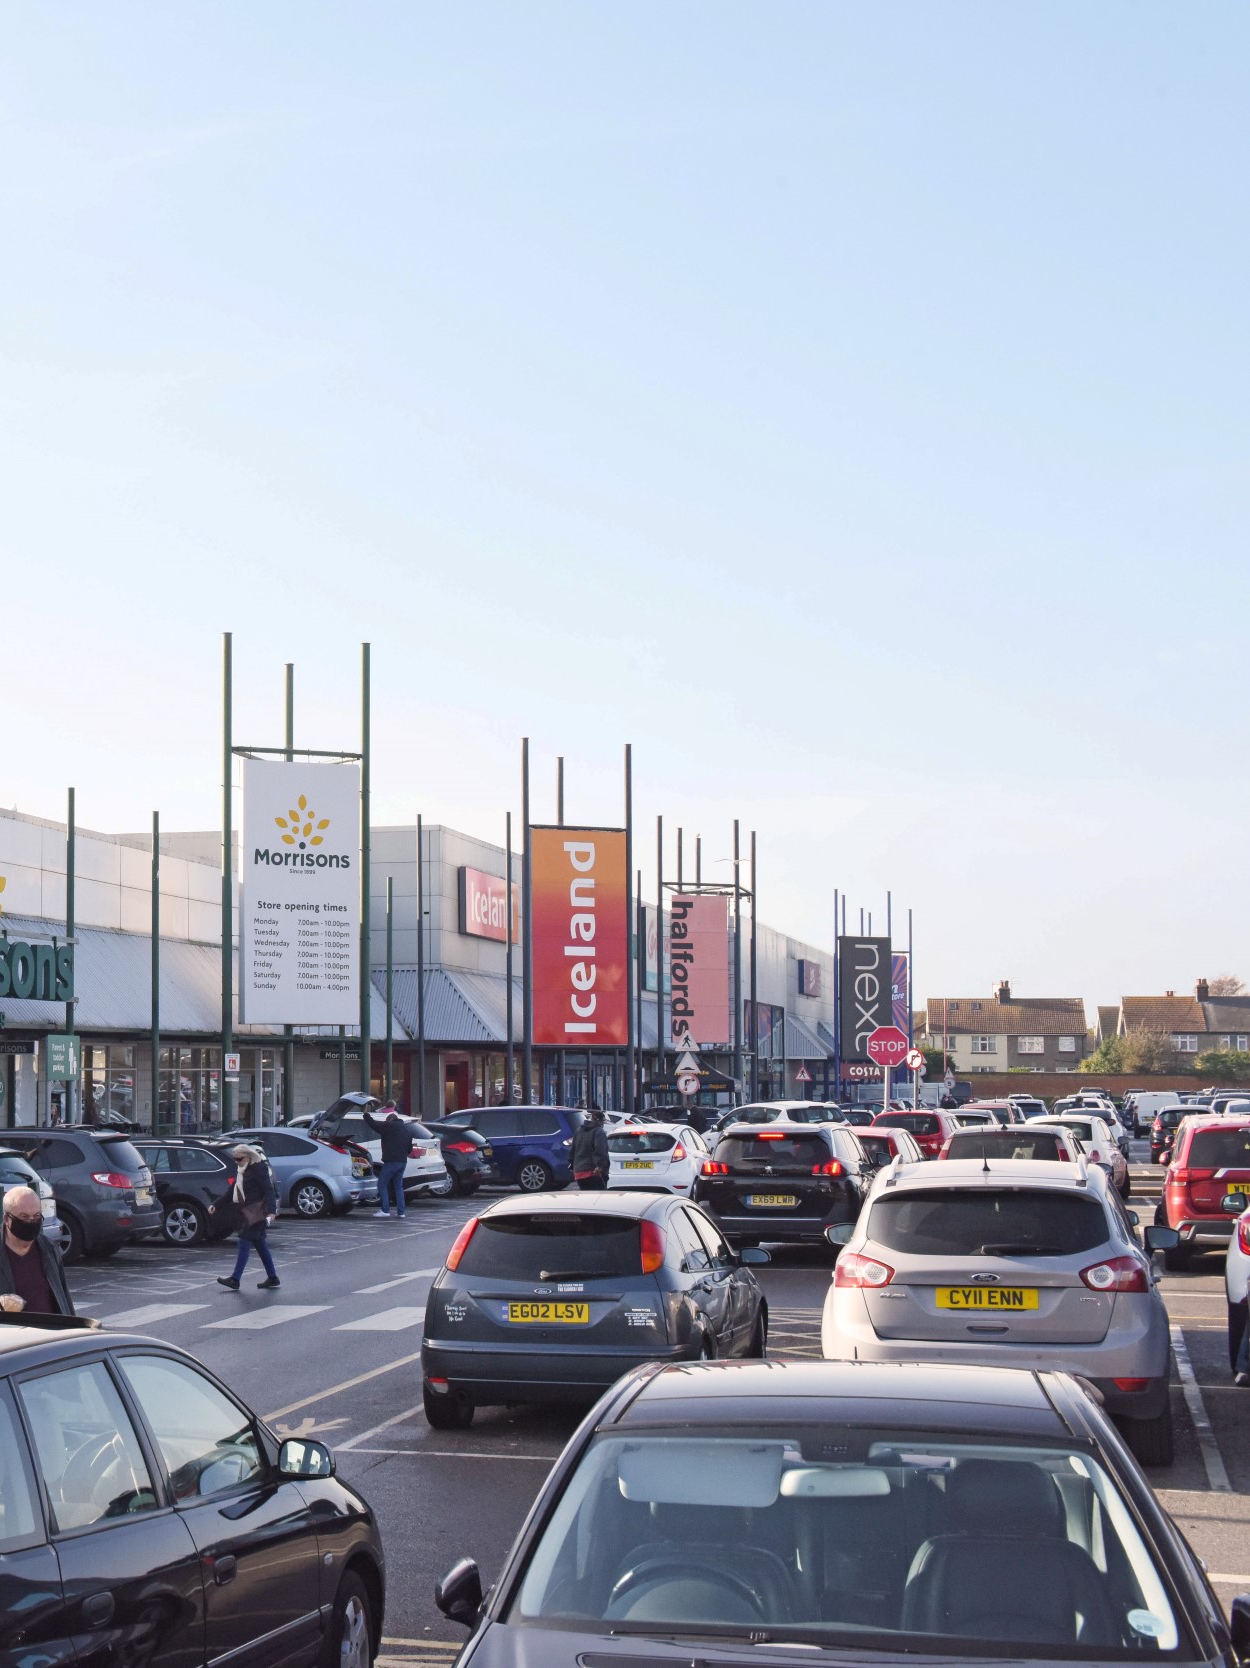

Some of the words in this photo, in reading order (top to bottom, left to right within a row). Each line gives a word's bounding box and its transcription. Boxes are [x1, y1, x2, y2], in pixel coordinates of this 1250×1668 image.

[254, 848, 350, 869] Morrisons
[258, 900, 281, 910] Store
[284, 902, 320, 913] opening
[323, 903, 348, 912] times
[254, 918, 279, 926] Monday
[563, 842, 596, 1033] Iceland
[254, 950, 282, 958] Thursday
[671, 901, 694, 1037] halfords
[254, 982, 276, 990] Sunday
[870, 1041, 905, 1051] STOP
[850, 1066, 880, 1076] COSTA
[752, 1196, 774, 1204] EX69
[776, 1196, 793, 1204] LWR
[950, 1290, 982, 1304] CY11
[988, 1290, 1023, 1305] ENN
[510, 1304, 549, 1318] EG02
[555, 1305, 584, 1318] LSV
